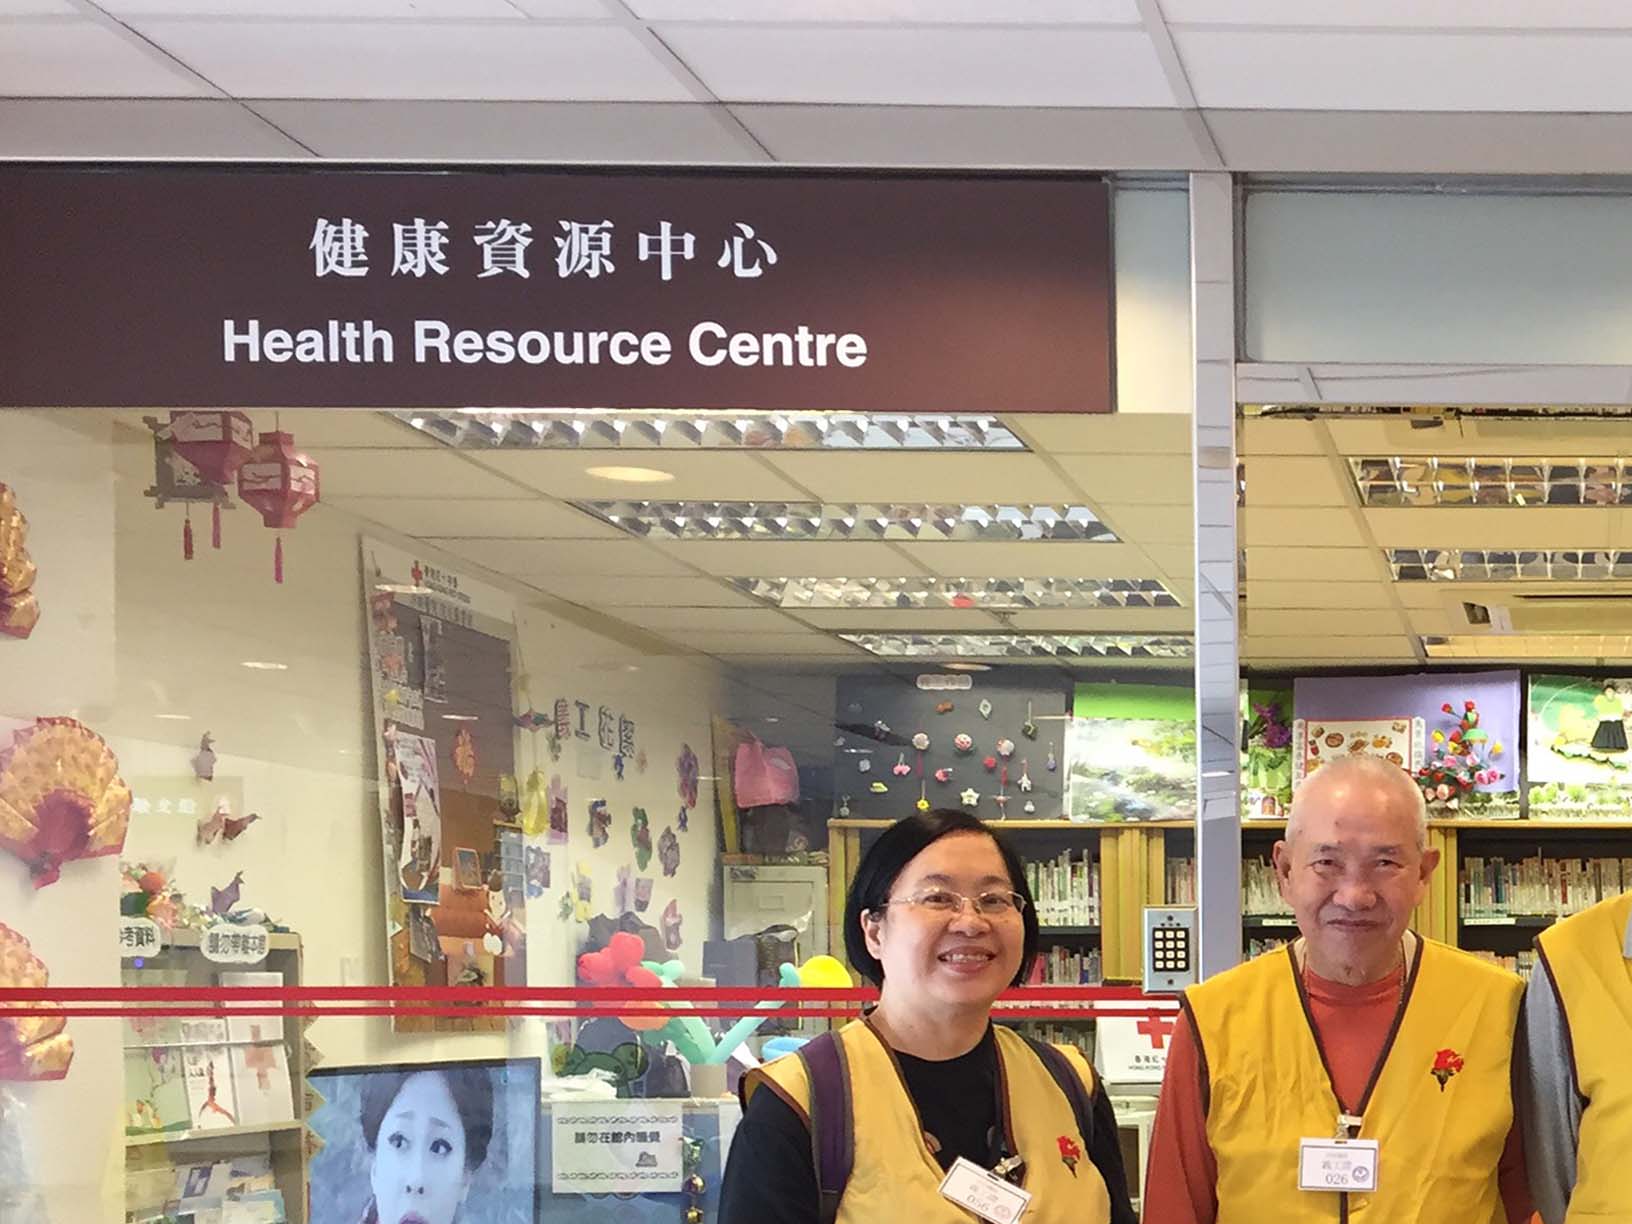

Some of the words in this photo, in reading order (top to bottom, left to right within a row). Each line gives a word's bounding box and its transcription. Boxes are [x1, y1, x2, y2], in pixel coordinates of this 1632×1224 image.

[309, 217, 778, 281] 健康資源中心
[223, 319, 394, 364] Health
[413, 319, 672, 366] Resource
[687, 321, 868, 369] Centre
[1325, 1173, 1349, 1185] 026
